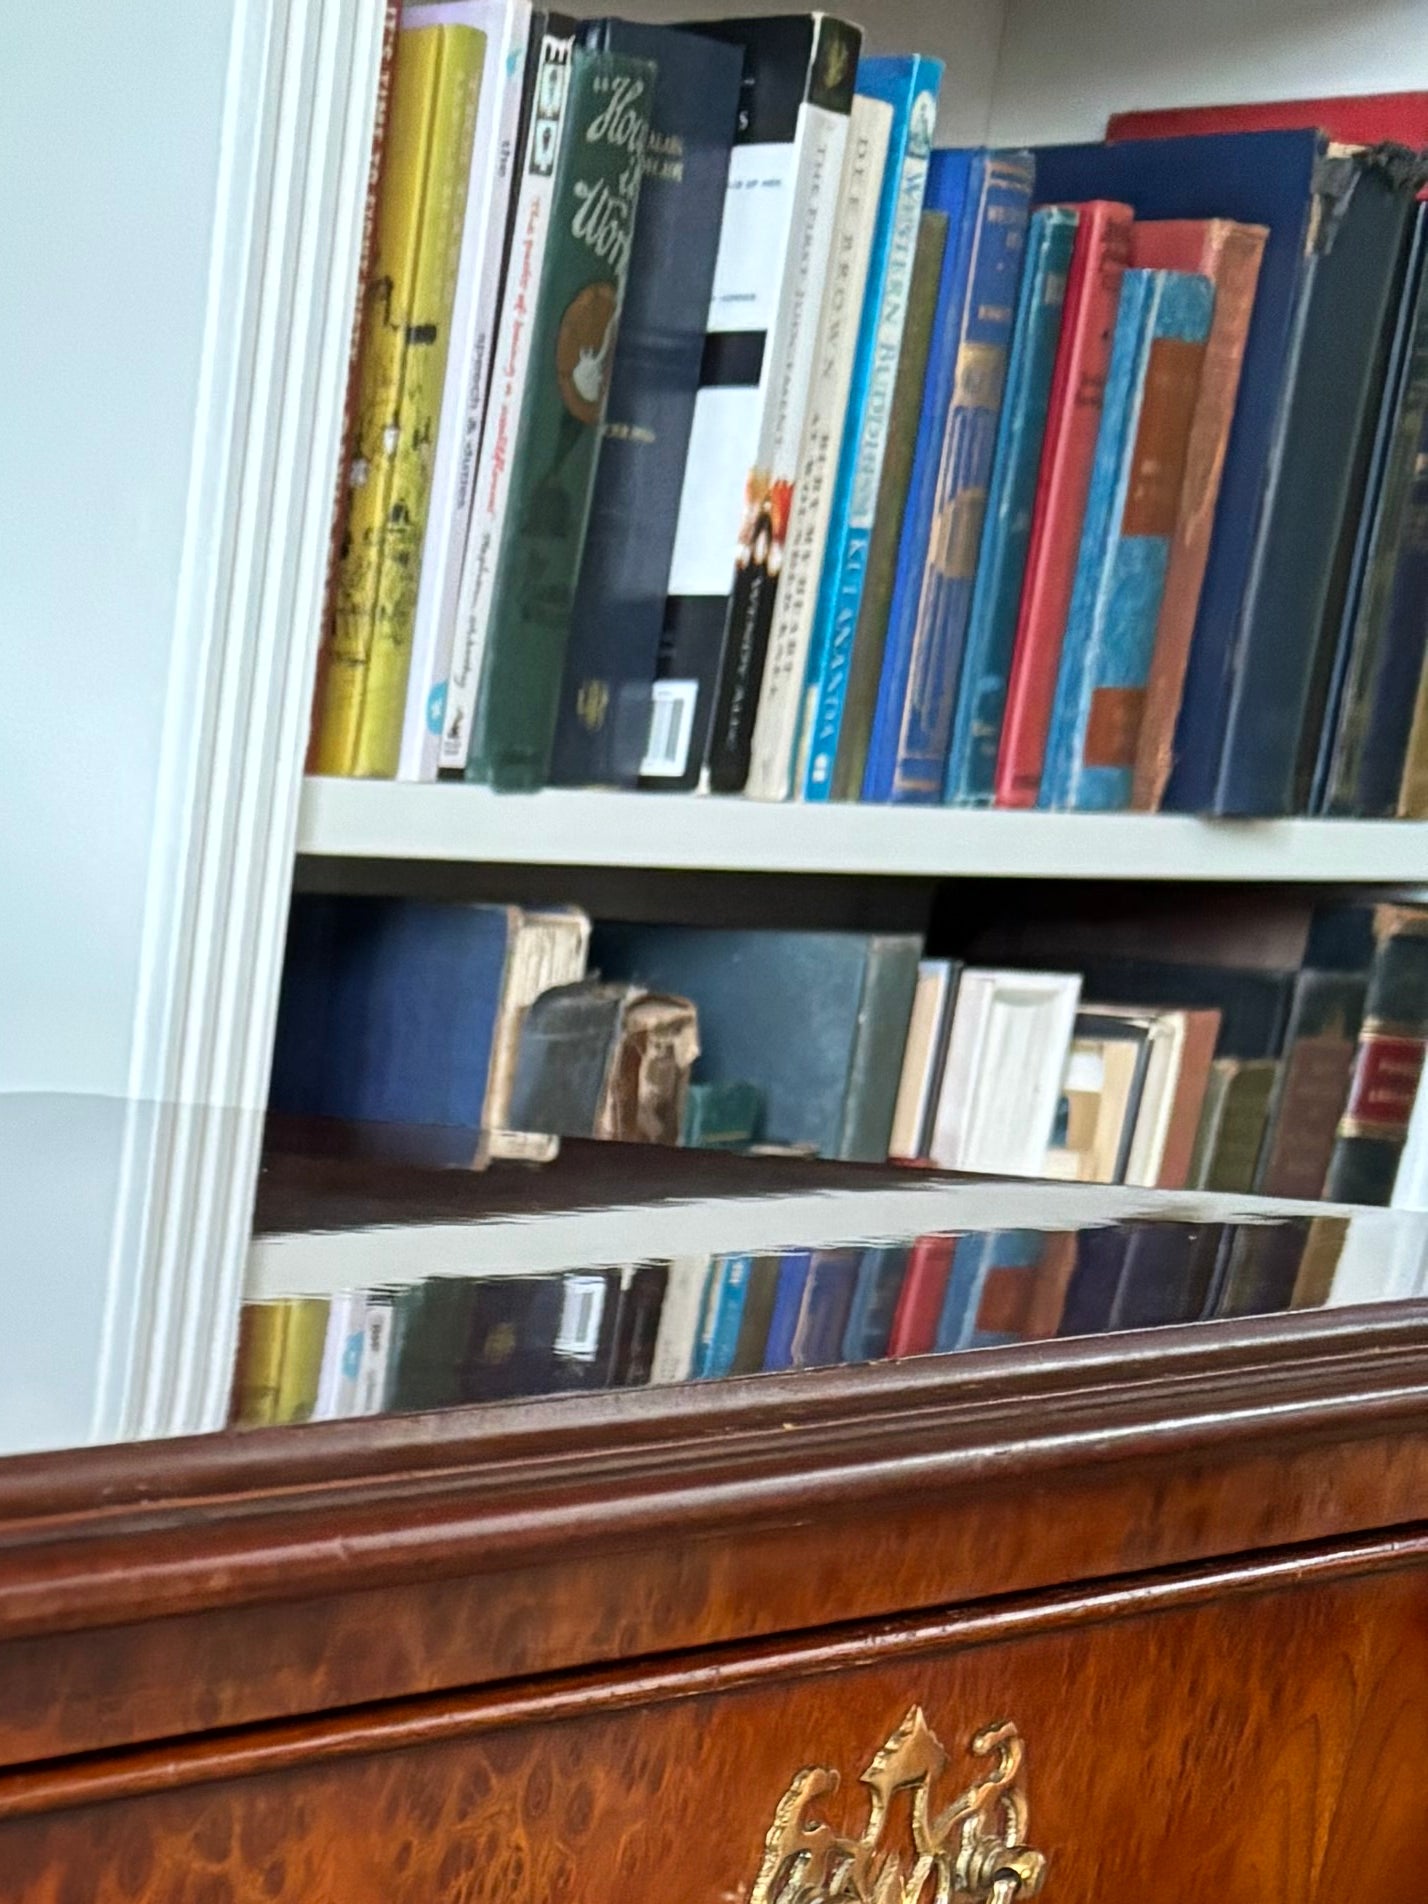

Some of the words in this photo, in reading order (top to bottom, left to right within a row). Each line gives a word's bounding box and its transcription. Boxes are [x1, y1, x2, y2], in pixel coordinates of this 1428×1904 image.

[824, 234, 853, 377] BROWN
[884, 171, 924, 324] WESTERN
[502, 319, 524, 377] being
[853, 343, 896, 517] BUDDHISM
